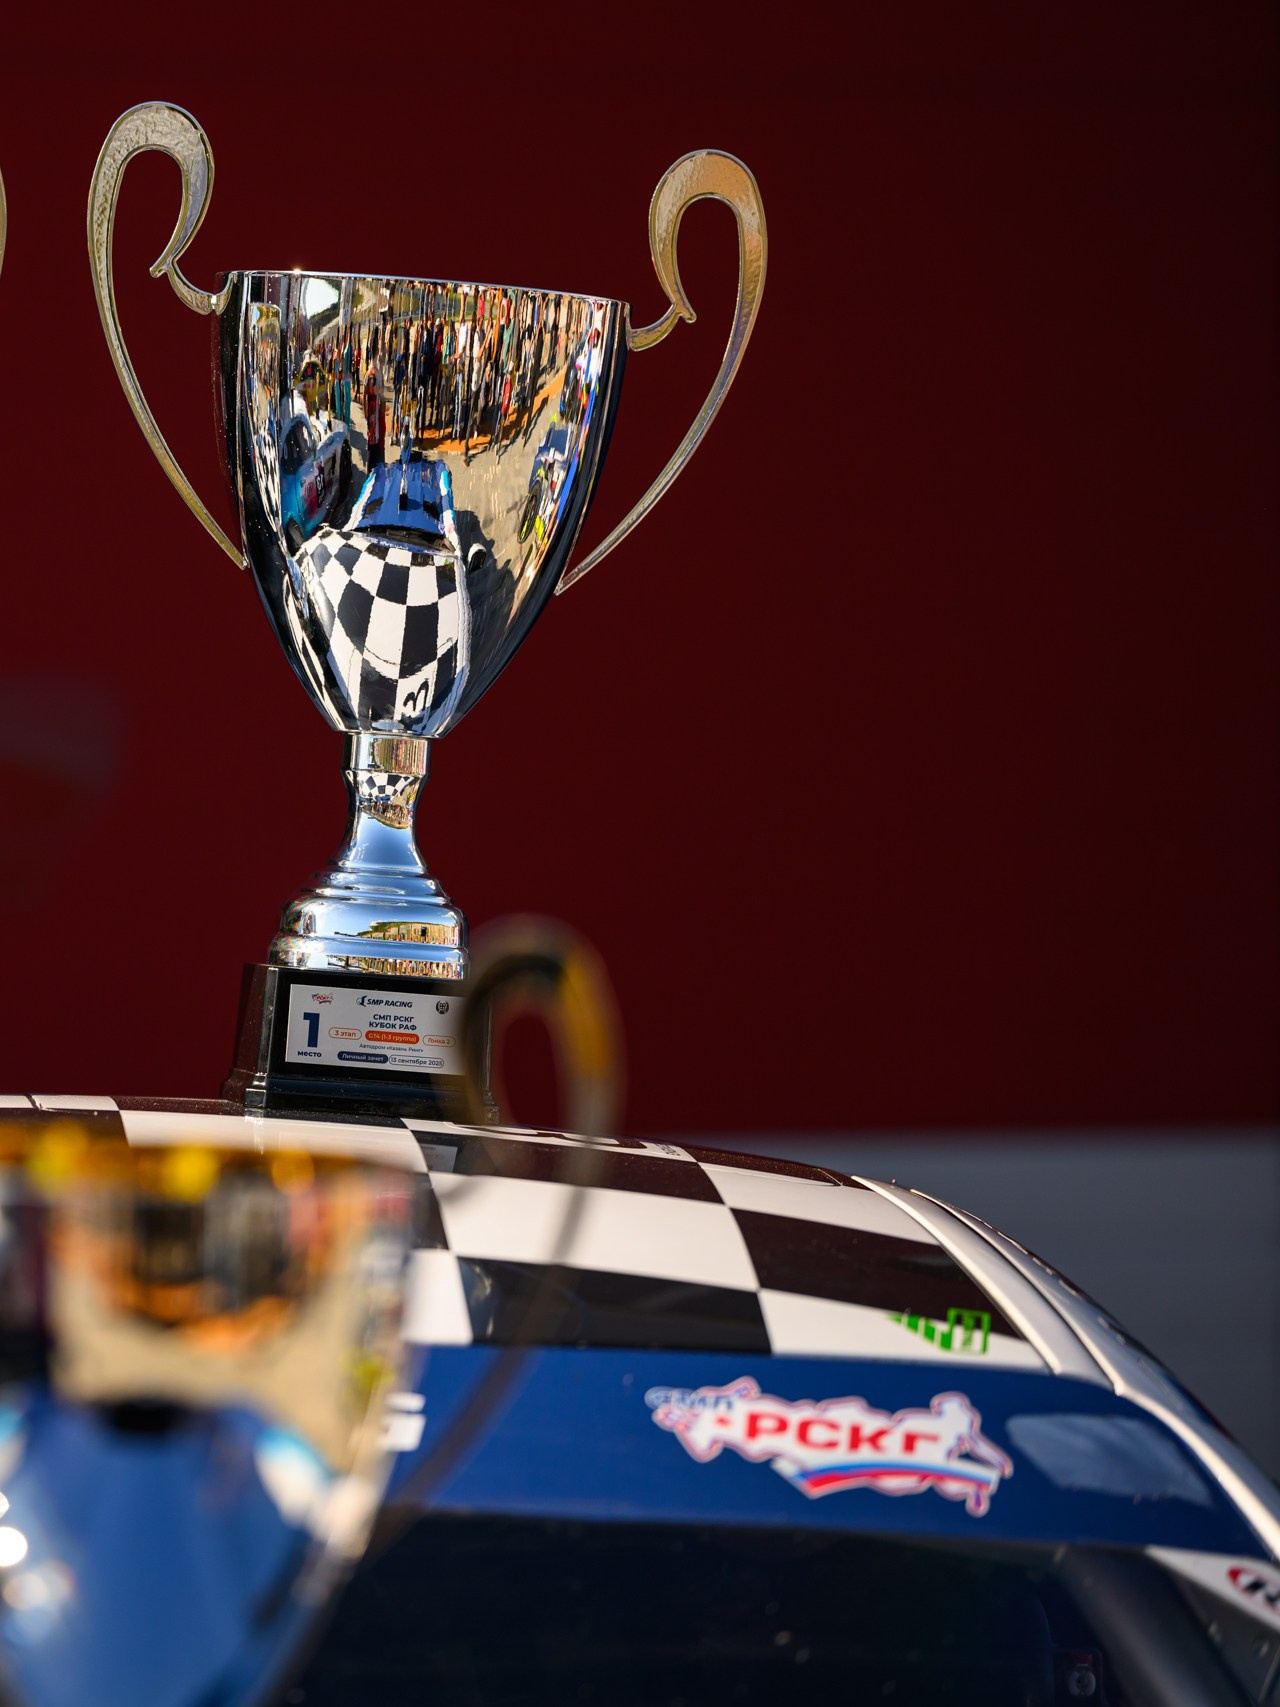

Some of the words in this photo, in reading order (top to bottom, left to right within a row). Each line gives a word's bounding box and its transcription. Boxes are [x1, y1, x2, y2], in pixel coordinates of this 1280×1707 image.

[367, 998, 383, 1006] SMP
[384, 1000, 413, 1008] RACING
[393, 1015, 414, 1023] РСКГ
[368, 1021, 397, 1029] КУБОК
[303, 1012, 320, 1047] 1
[392, 1035, 417, 1043] группа)
[397, 1058, 427, 1066] сентября
[744, 1410, 942, 1456] РСКГ
